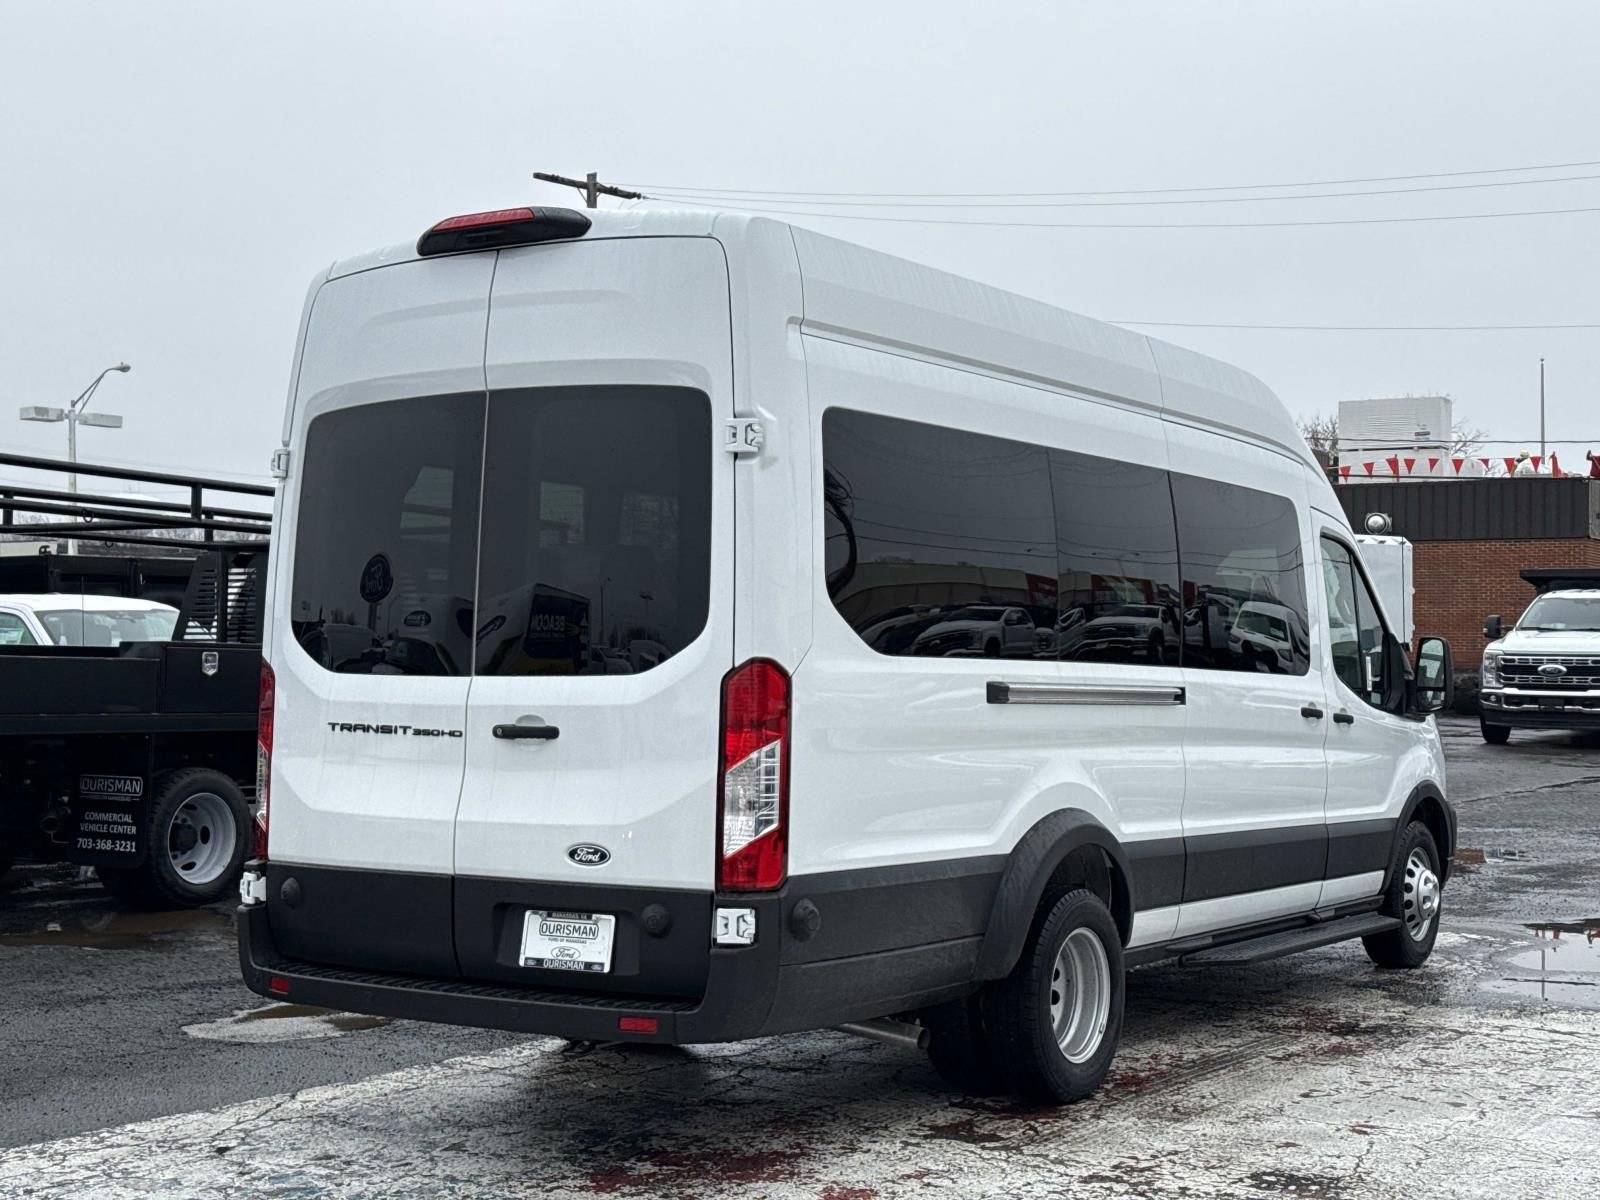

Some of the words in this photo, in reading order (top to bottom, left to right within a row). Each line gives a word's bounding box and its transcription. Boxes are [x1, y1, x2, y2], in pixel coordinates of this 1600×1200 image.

[328, 722, 412, 735] TRANSIT
[82, 778, 140, 793] OURISMAN
[84, 812, 133, 823] COMMERCIAL
[80, 823, 108, 833] VEHICLE
[109, 825, 136, 835] CENTER
[77, 838, 136, 852] 703-368-3231
[574, 847, 601, 862] Ford
[541, 922, 597, 937] OURISMAN
[556, 947, 576, 959] Ford
[543, 959, 585, 970] OURISMAN
